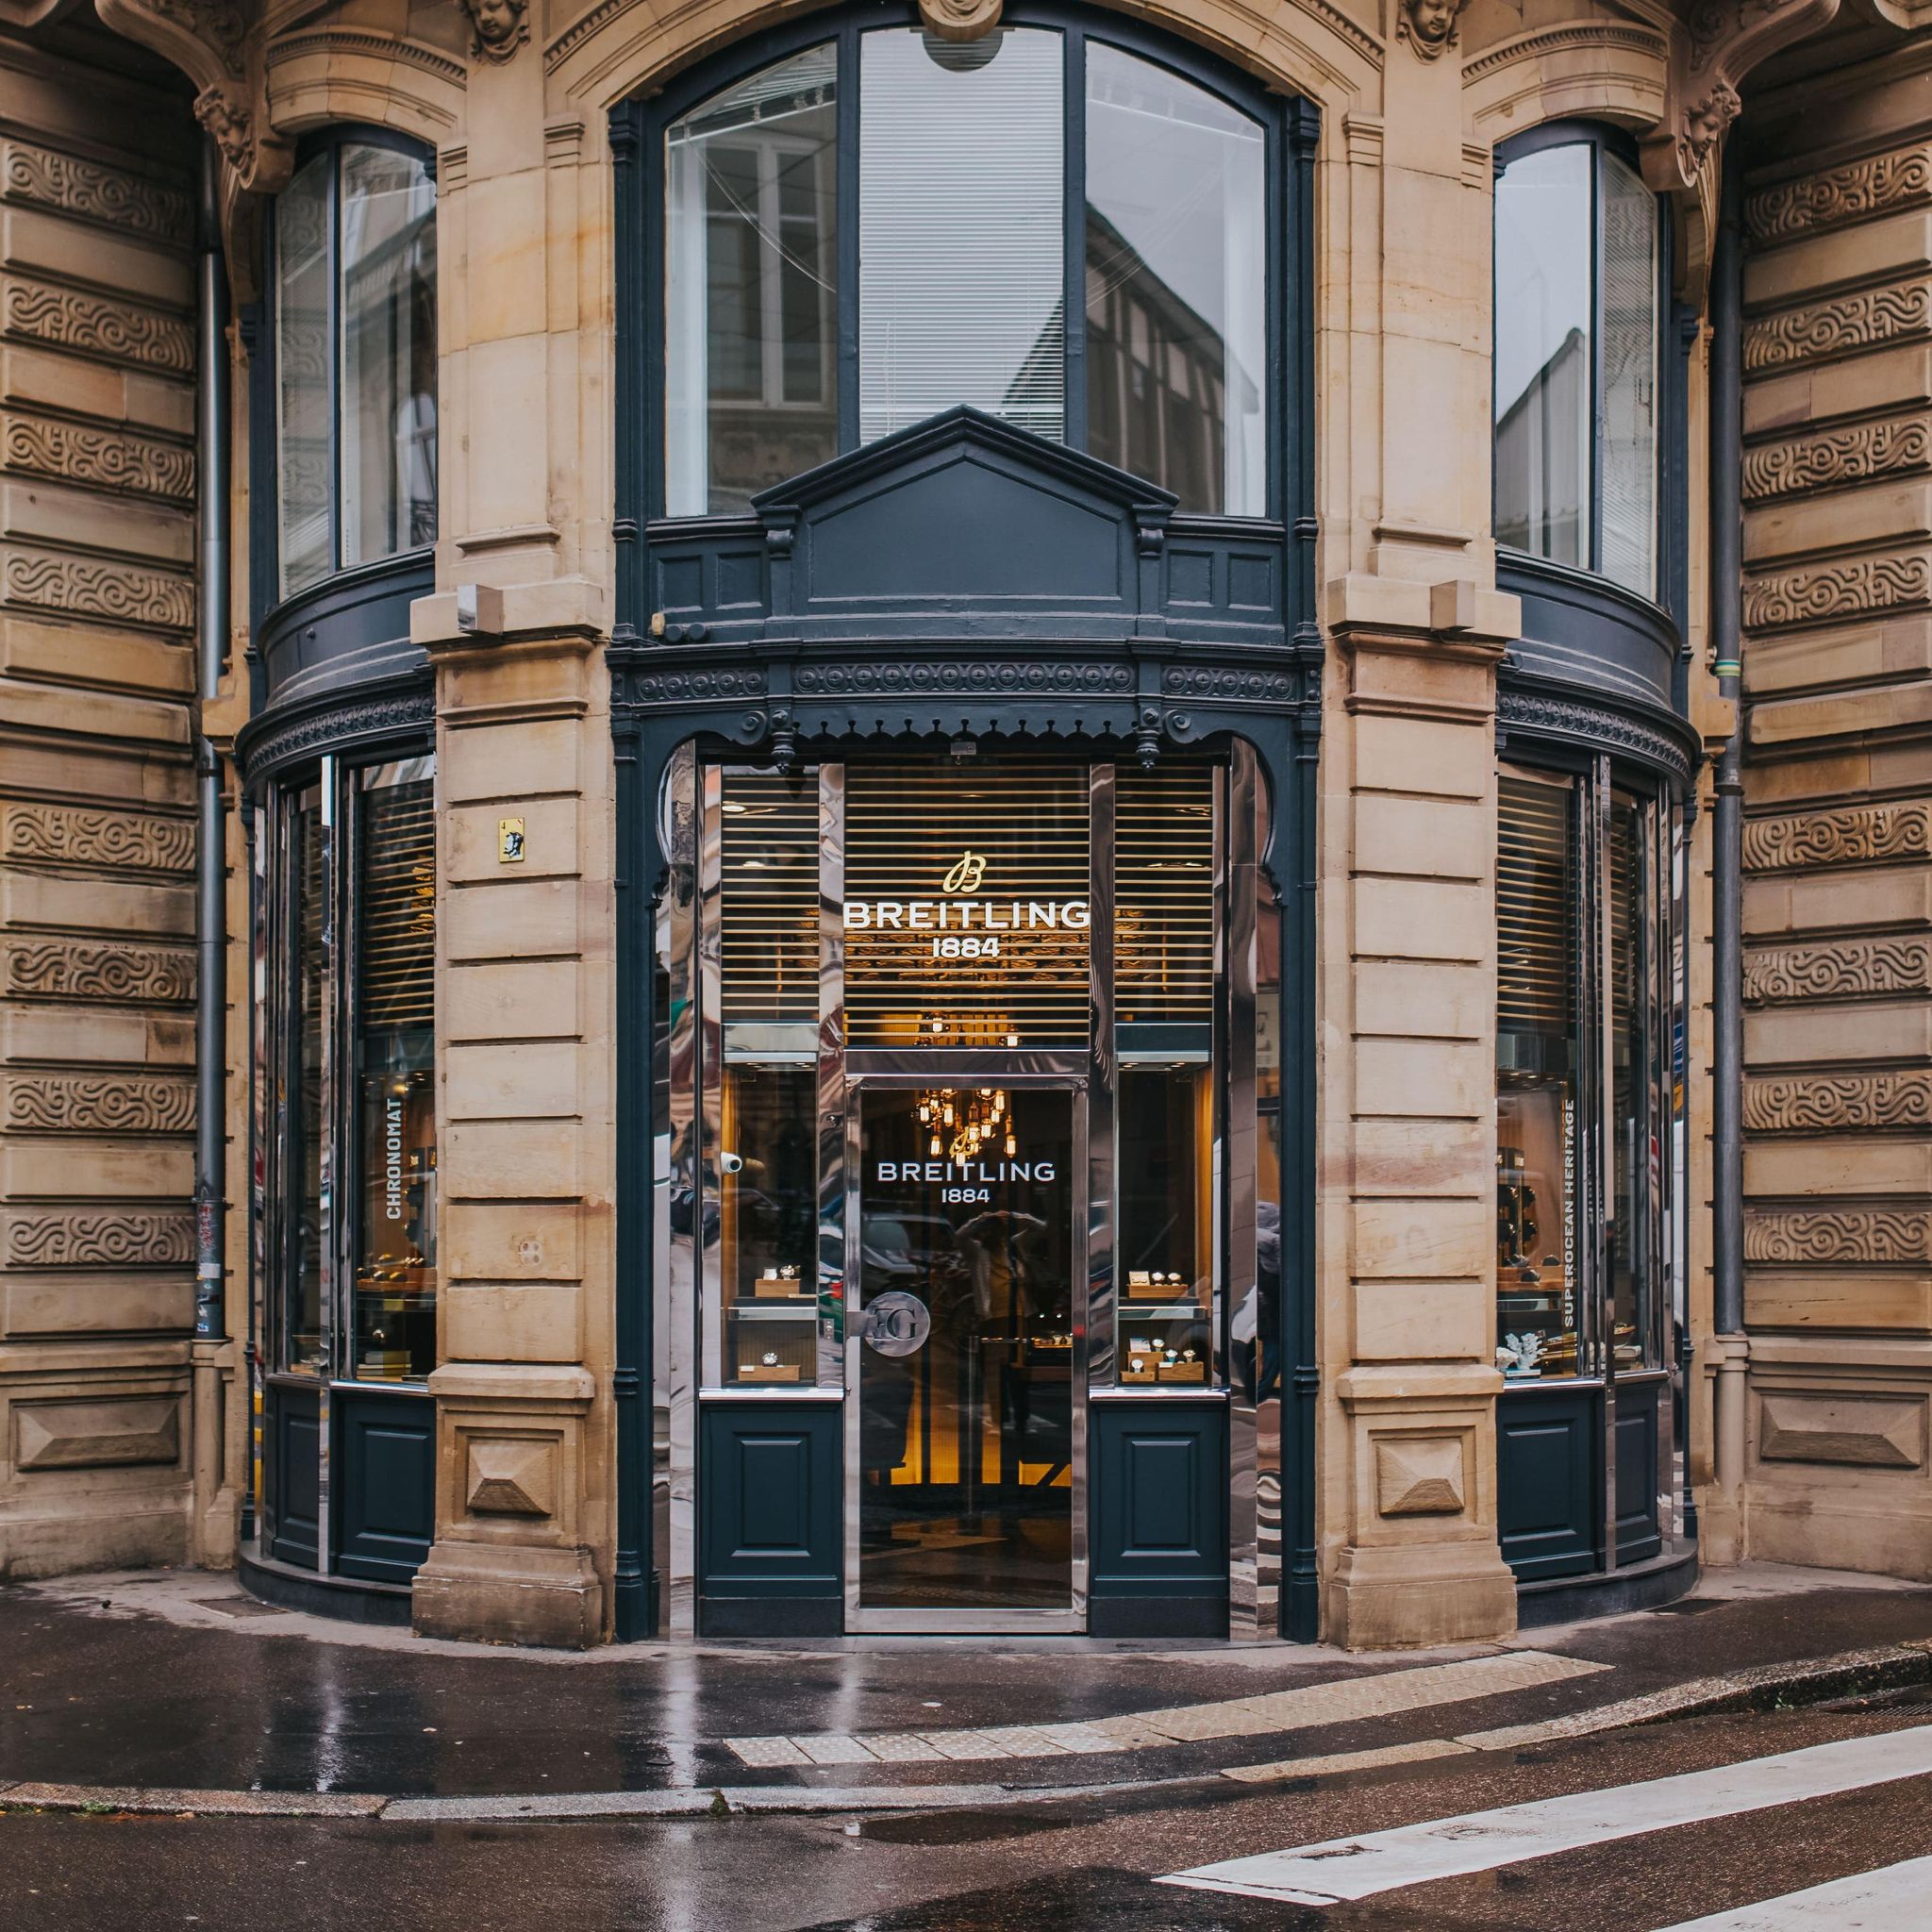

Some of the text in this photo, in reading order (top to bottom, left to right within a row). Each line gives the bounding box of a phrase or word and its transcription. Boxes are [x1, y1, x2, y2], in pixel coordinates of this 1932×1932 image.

[842, 902, 1090, 928] BREITLING
[932, 938, 999, 958] 1884
[387, 1098, 402, 1220] CHRONOMAT
[877, 1162, 1056, 1182] BREITLING
[941, 1189, 990, 1204] 1884
[1564, 1099, 1574, 1327] SUPEROCEAN HERITAGE
